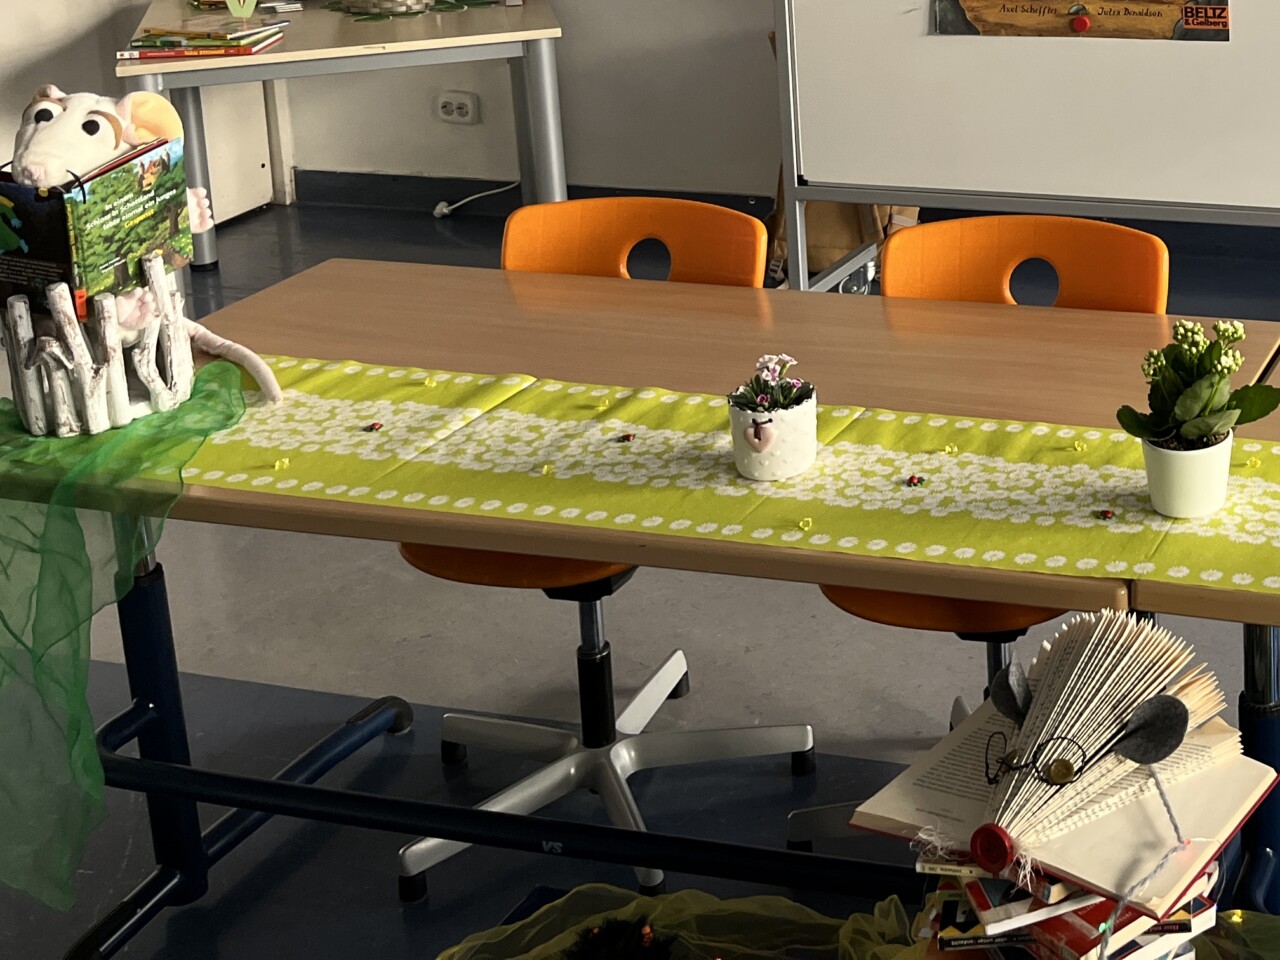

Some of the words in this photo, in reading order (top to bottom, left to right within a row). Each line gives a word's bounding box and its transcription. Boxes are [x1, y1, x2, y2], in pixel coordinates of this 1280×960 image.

[999, 4, 1018, 14] Axel
[1184, 6, 1227, 19] BELTZ
[1191, 19, 1228, 29] Gelberg
